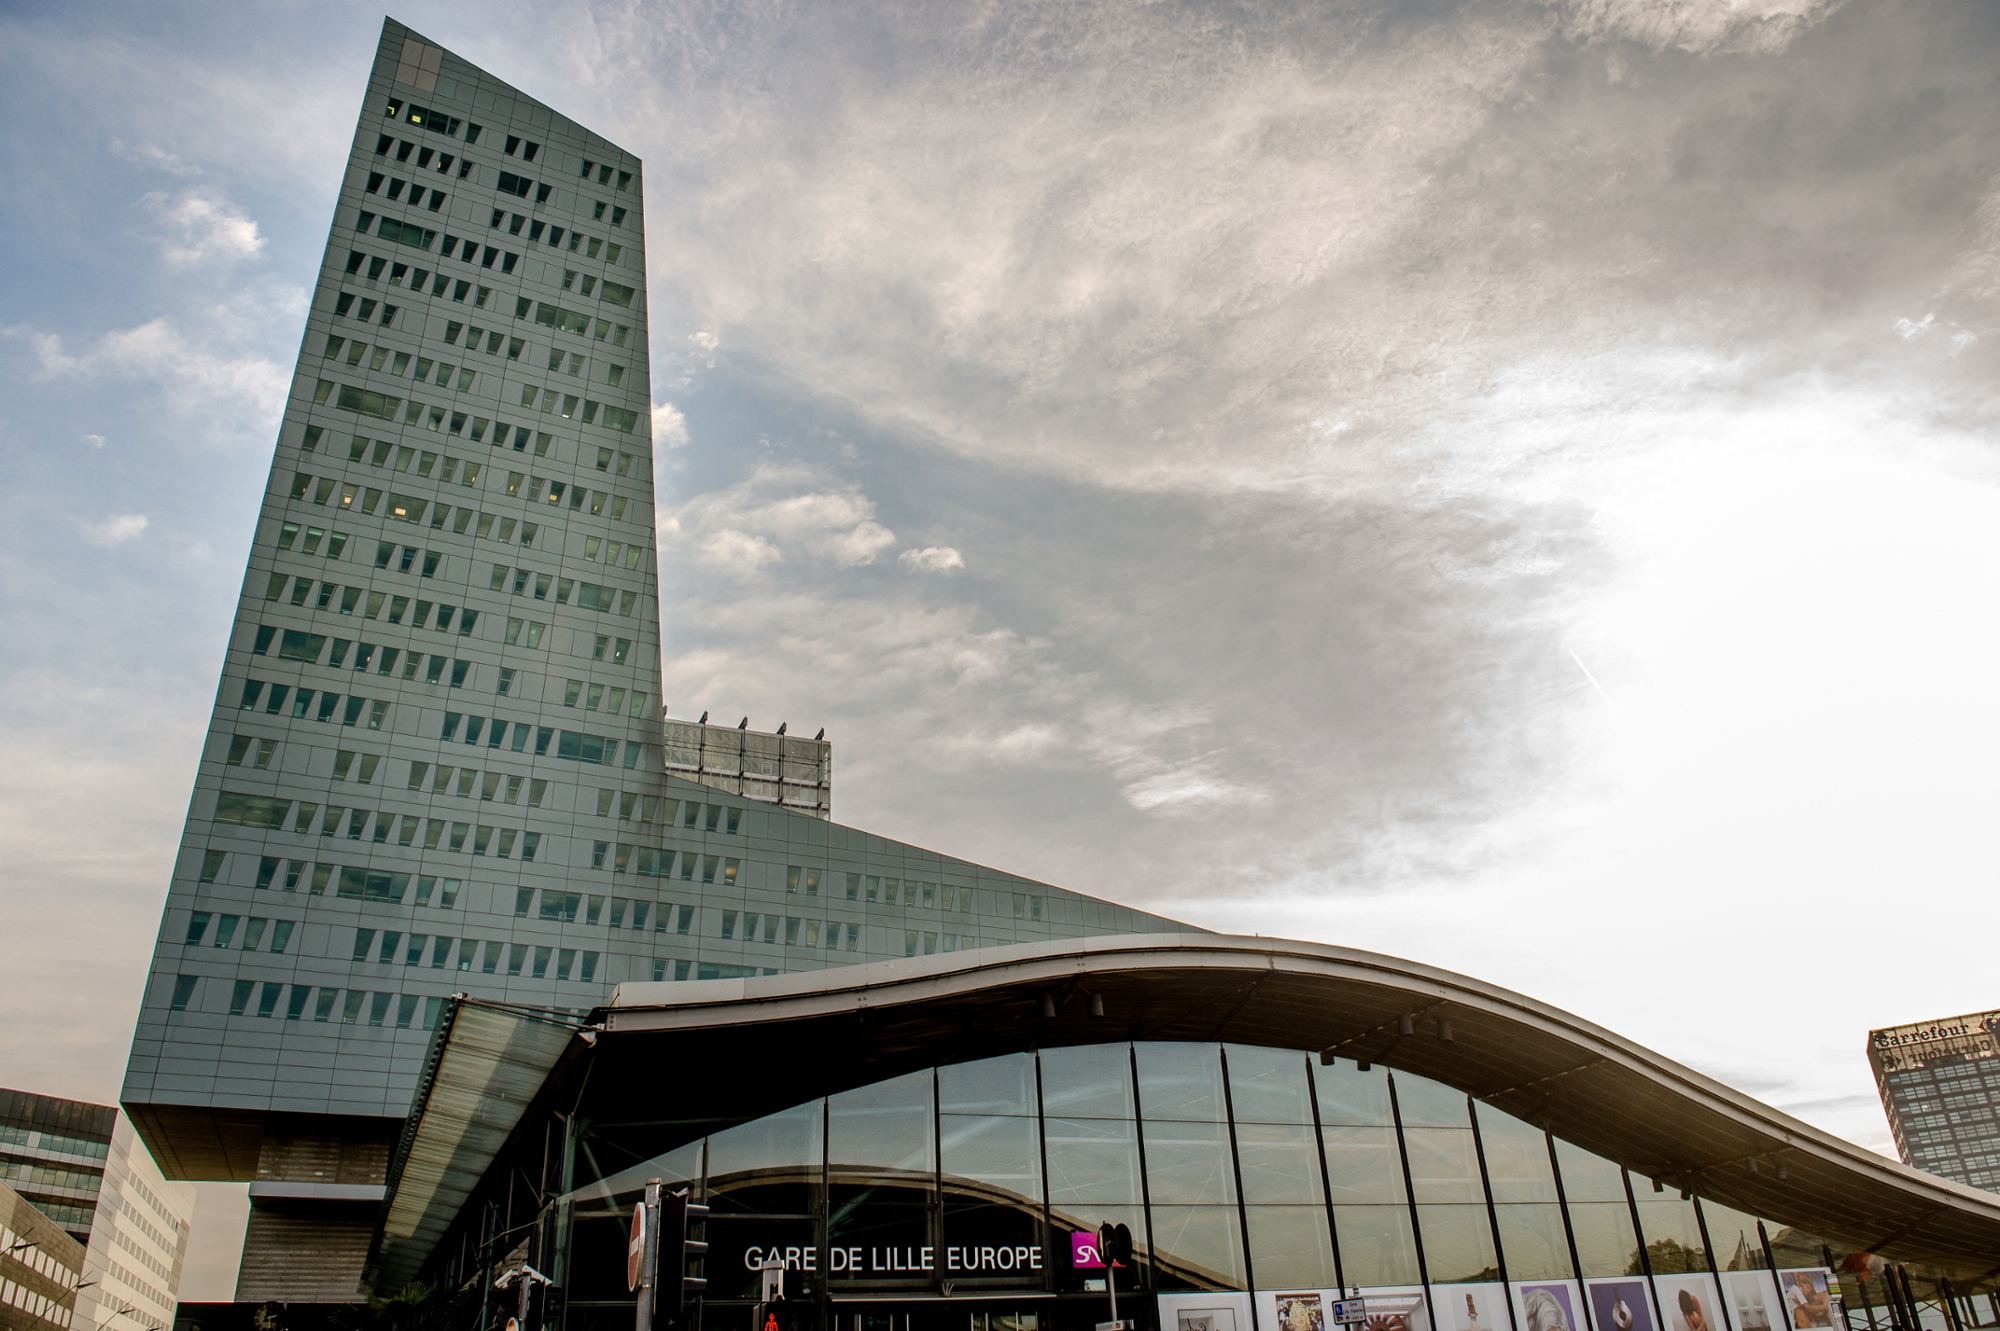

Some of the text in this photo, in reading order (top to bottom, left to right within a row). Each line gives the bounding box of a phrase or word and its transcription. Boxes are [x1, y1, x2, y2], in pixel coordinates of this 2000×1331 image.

[1878, 1024, 1969, 1047] Carrefour
[744, 1246, 1043, 1271] GARE DE LILLE EUROPE
